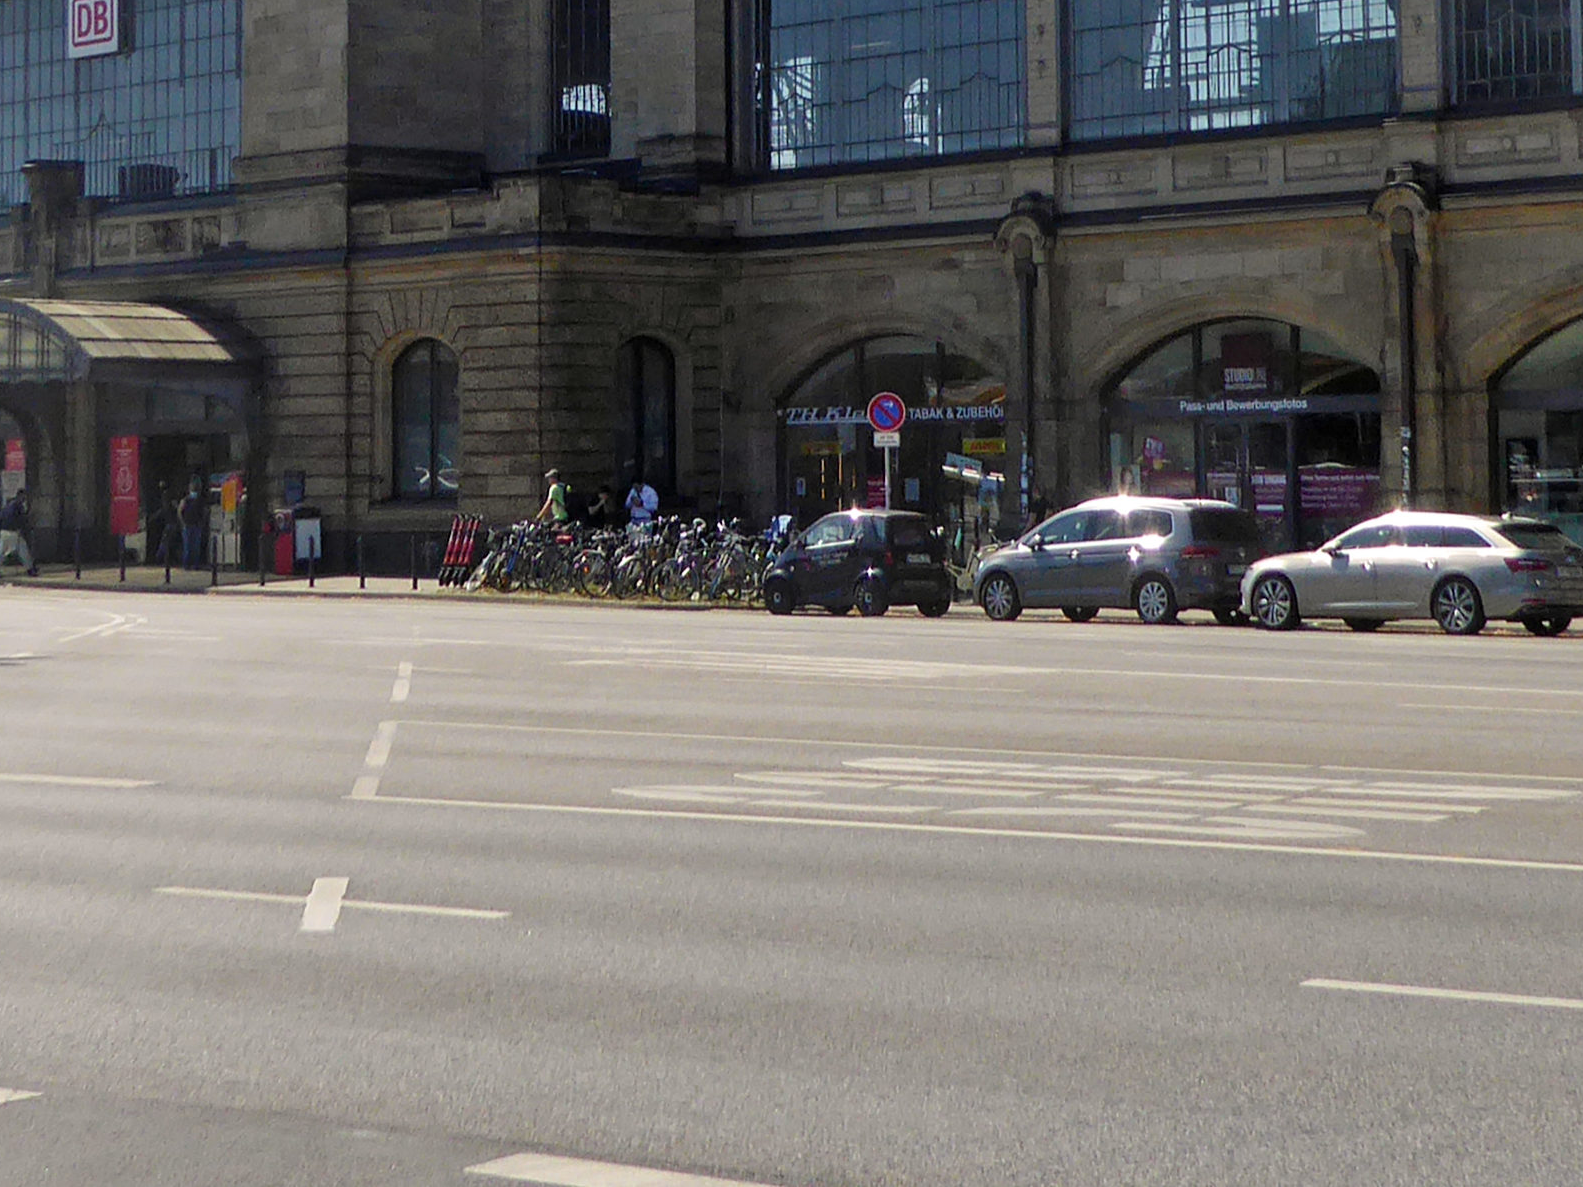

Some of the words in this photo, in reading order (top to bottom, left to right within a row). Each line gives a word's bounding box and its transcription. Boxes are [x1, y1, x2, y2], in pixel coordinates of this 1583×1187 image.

[78, 0, 109, 38] DB
[1206, 400, 1225, 411] und
[1226, 399, 1308, 412] Bewerbungsfotos
[908, 408, 944, 420] TABAK
[946, 407, 954, 419] &
